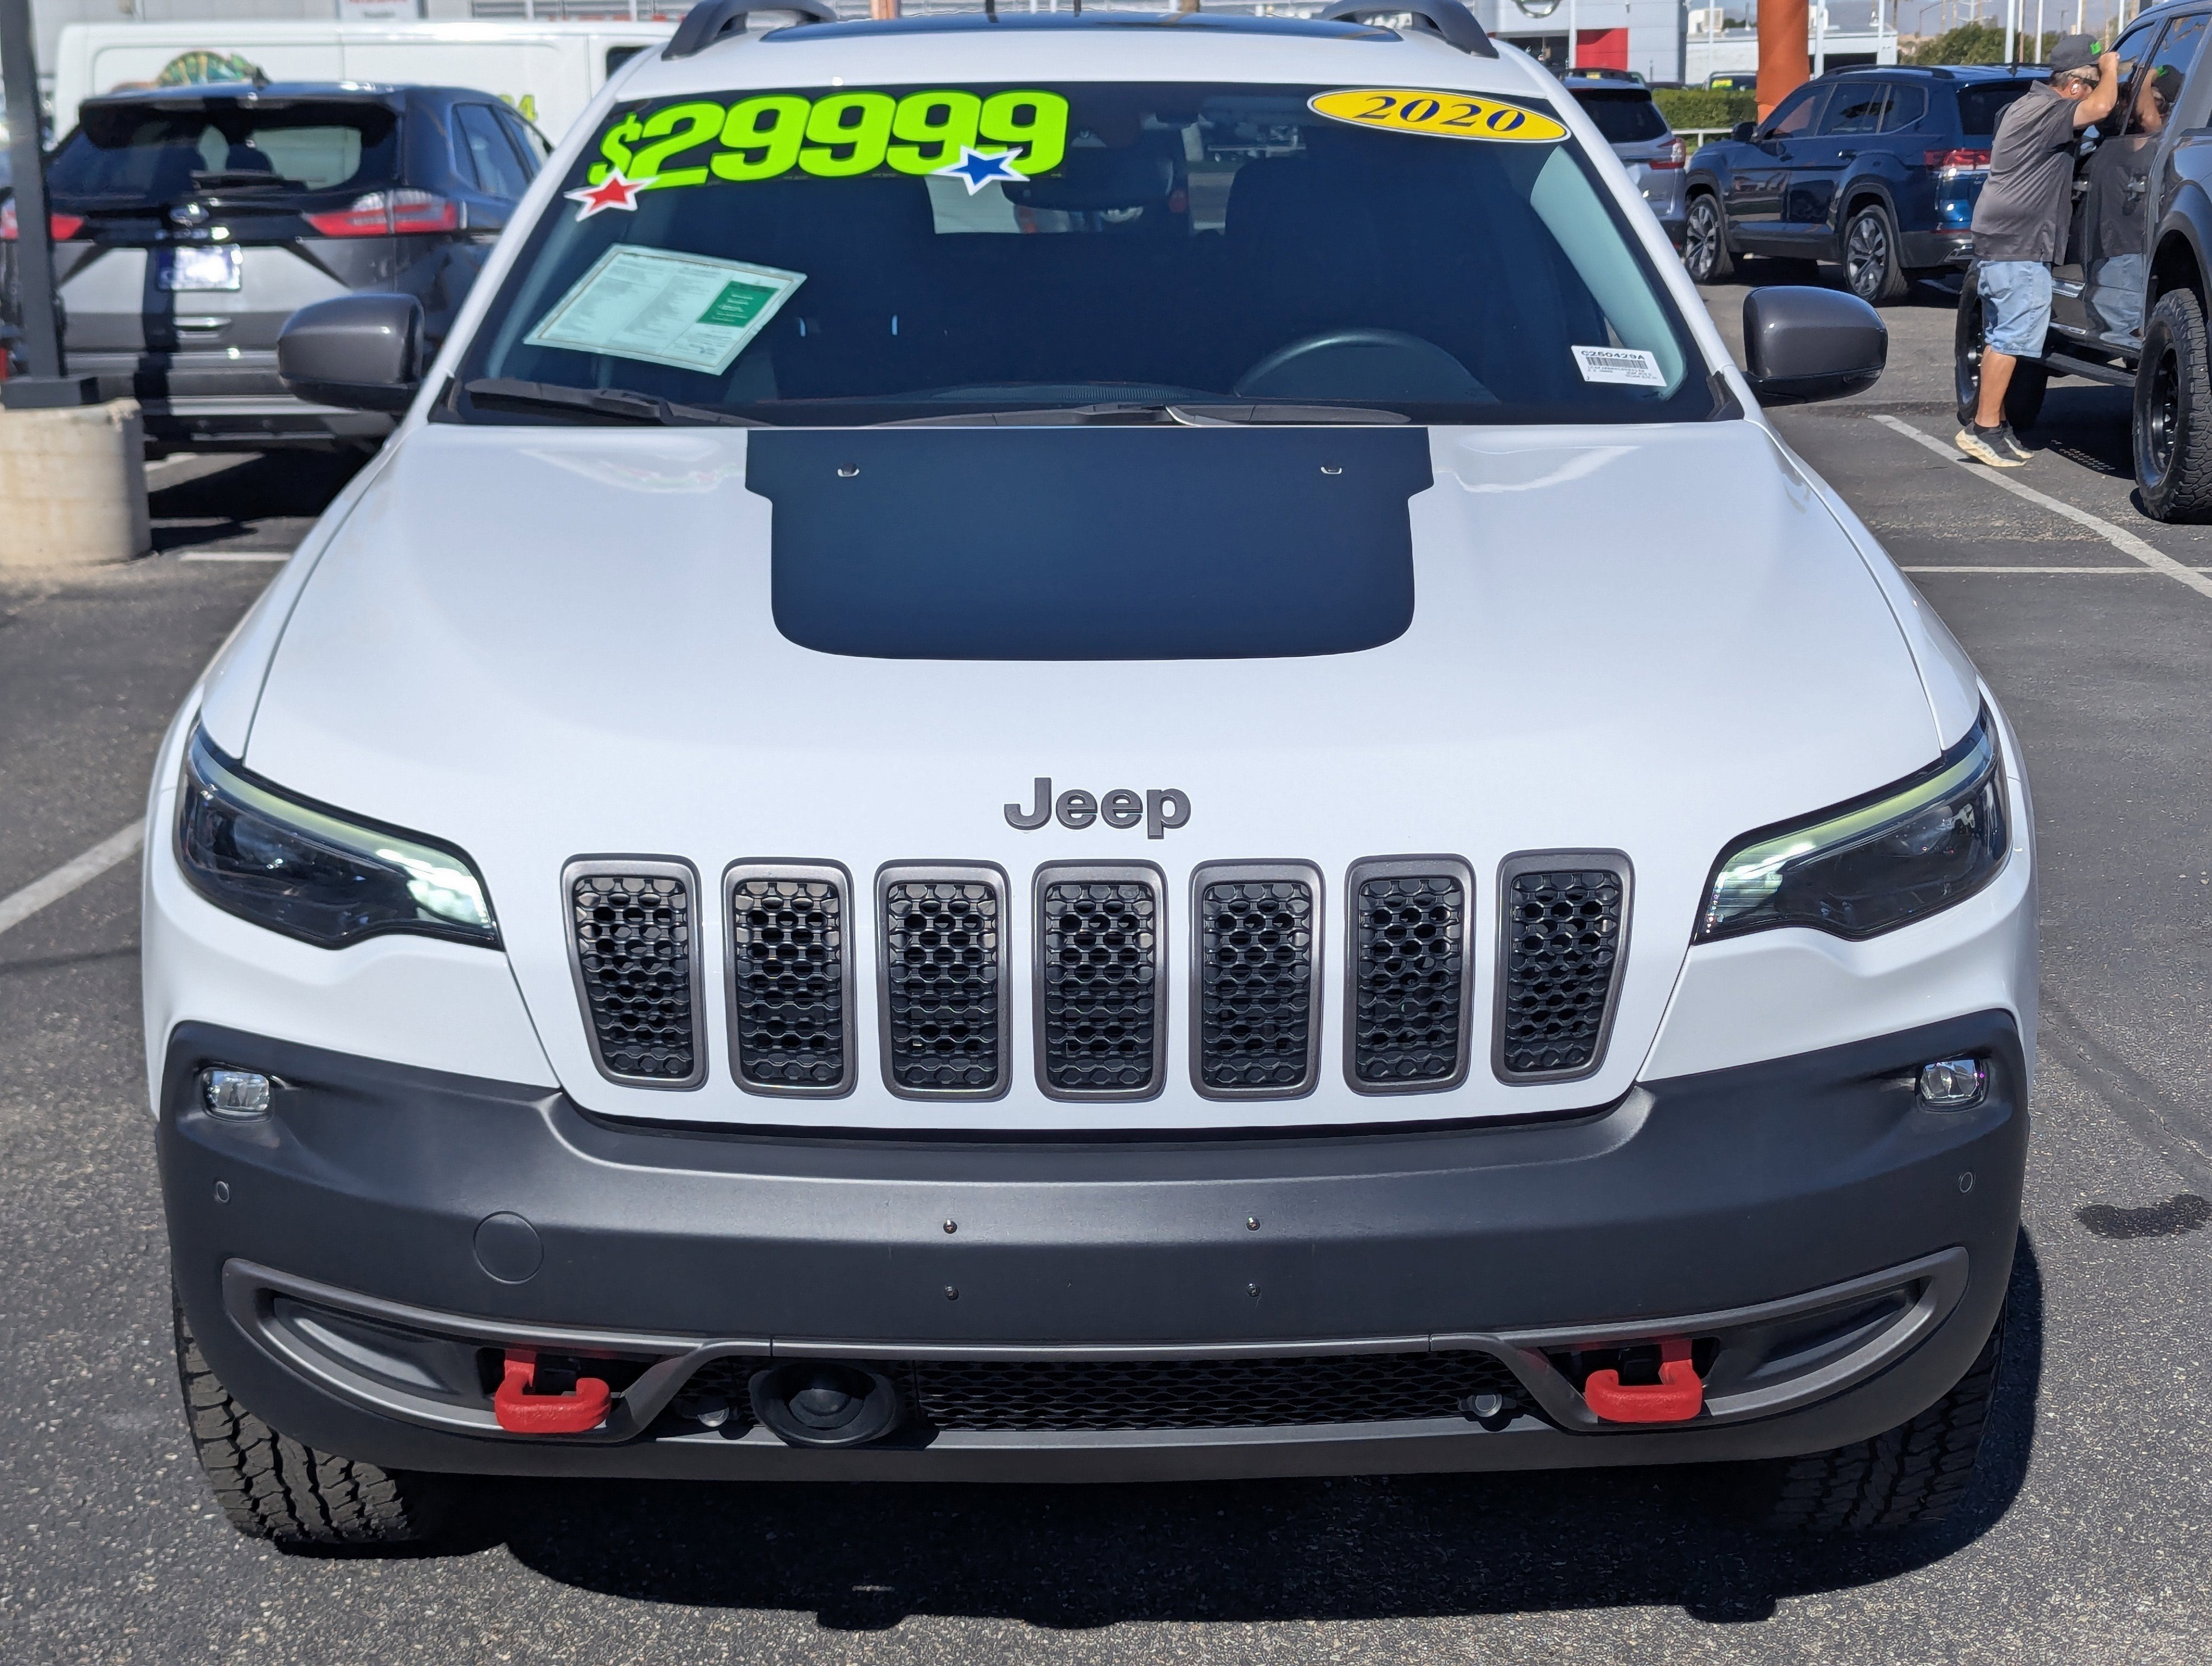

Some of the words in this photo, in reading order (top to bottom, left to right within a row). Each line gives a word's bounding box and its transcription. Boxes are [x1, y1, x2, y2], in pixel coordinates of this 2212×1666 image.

[587, 91, 1069, 189] $29999
[1352, 95, 1526, 132] 2020
[1004, 777, 1191, 840] Jeep
